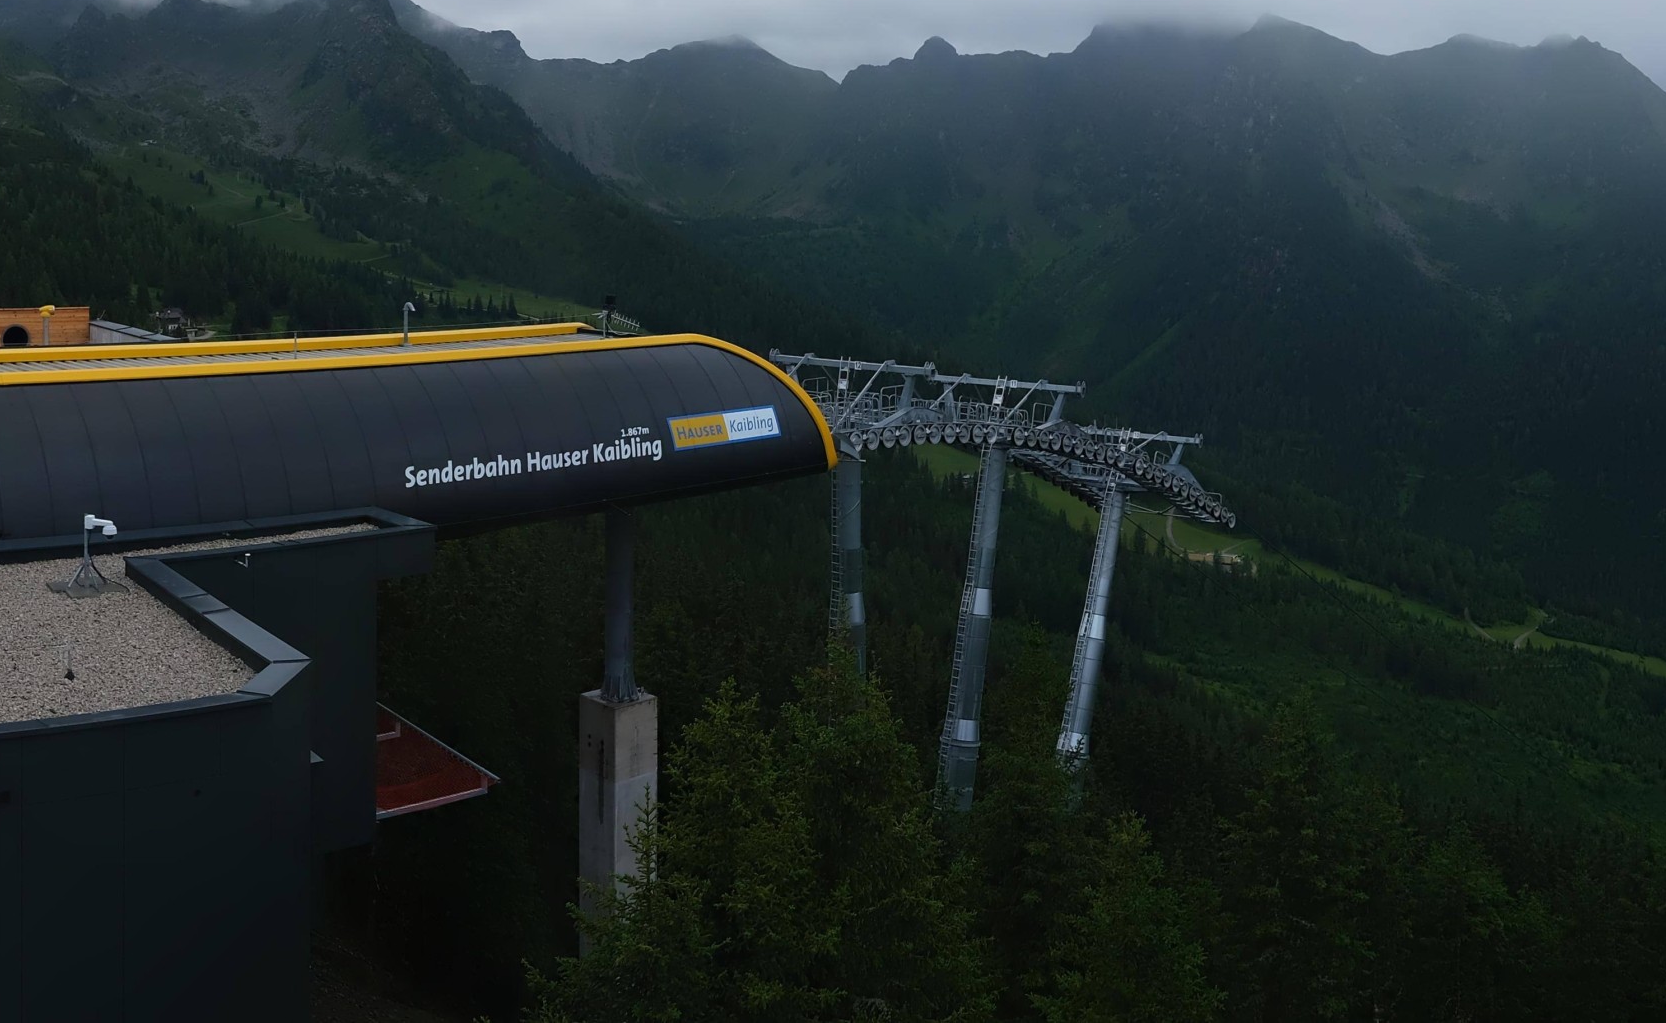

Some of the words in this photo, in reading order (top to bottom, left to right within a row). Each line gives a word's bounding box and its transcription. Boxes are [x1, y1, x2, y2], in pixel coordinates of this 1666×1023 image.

[620, 426, 650, 438] 1.867m
[676, 423, 723, 440] HAUSER
[729, 415, 774, 434] Kaibling
[405, 455, 522, 488] Senderbahn
[527, 449, 589, 473] Hauser
[593, 437, 663, 464] Kaibling
